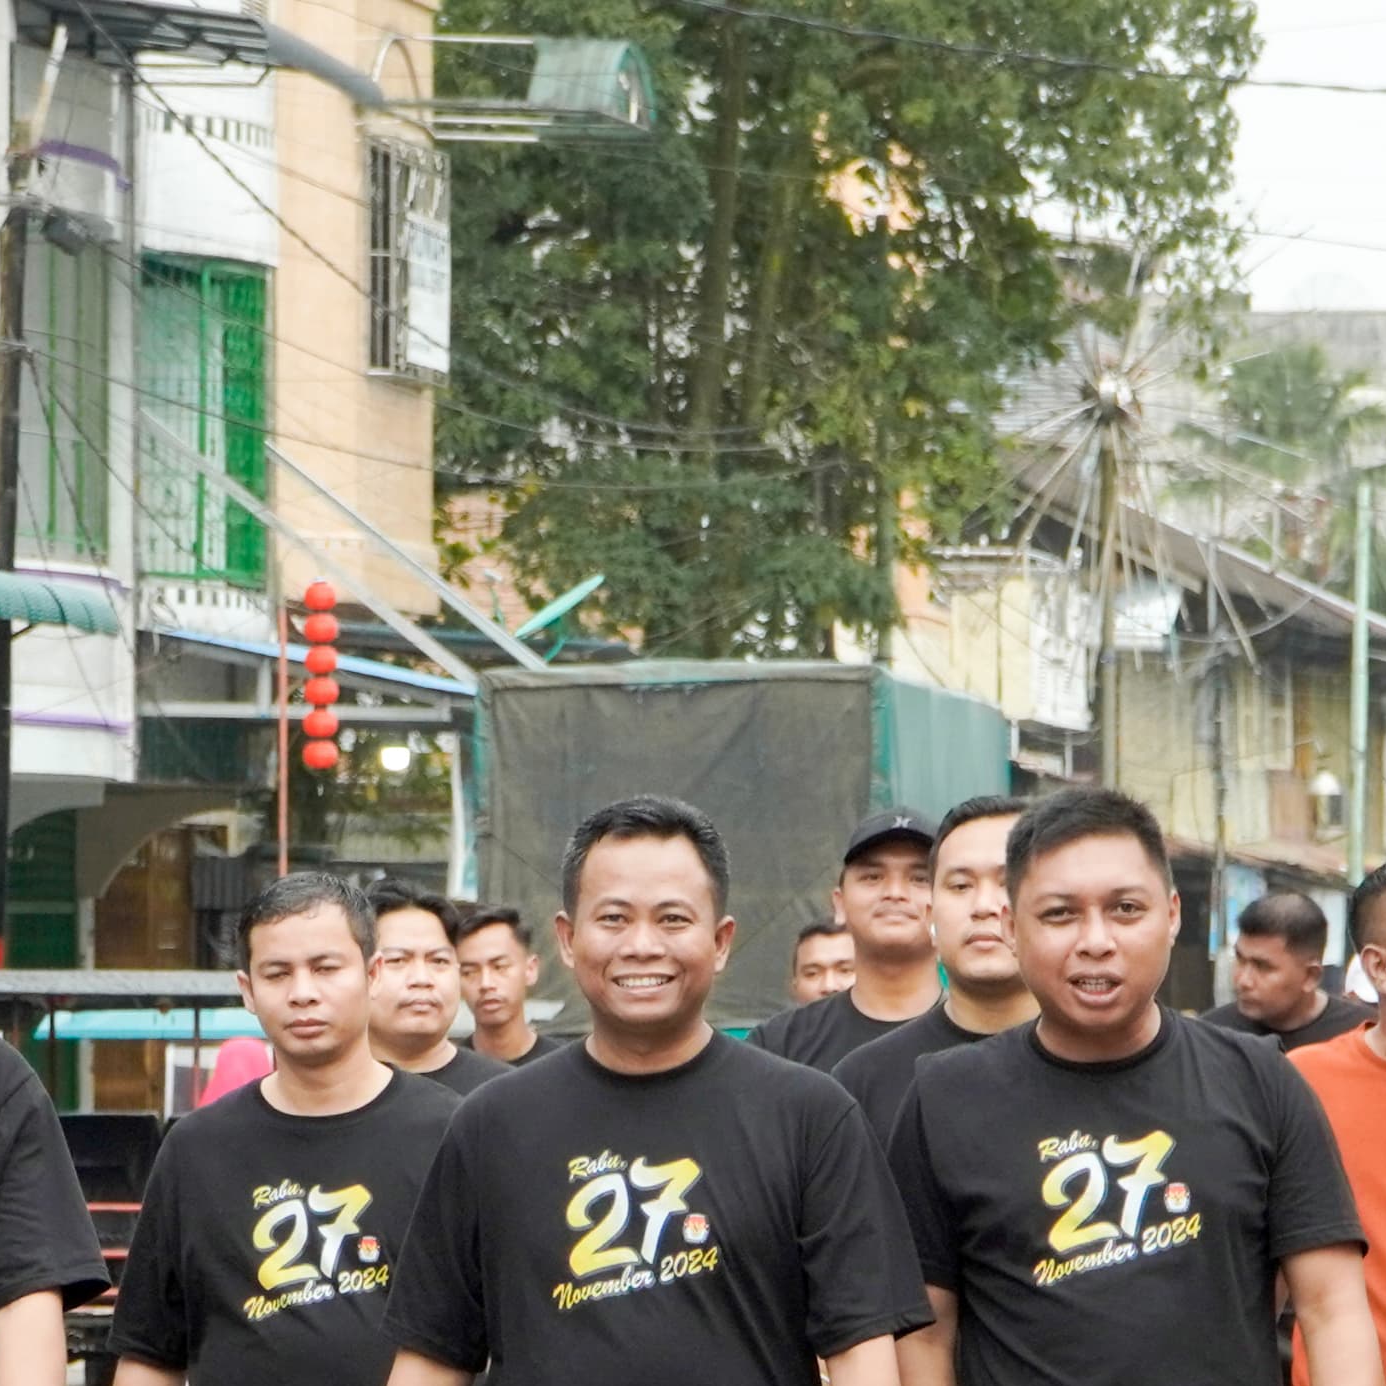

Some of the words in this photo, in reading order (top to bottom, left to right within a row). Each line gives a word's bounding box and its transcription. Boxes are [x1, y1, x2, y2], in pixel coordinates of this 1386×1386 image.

[566, 1157, 702, 1278] 27
[1042, 1130, 1176, 1253] 27
[252, 1184, 373, 1290] 27
[552, 1264, 655, 1310] November
[660, 1246, 718, 1284] 2024
[1032, 1239, 1137, 1287] November
[1142, 1212, 1202, 1255] 2024
[243, 1279, 334, 1320] November
[338, 1264, 389, 1294] 2024
